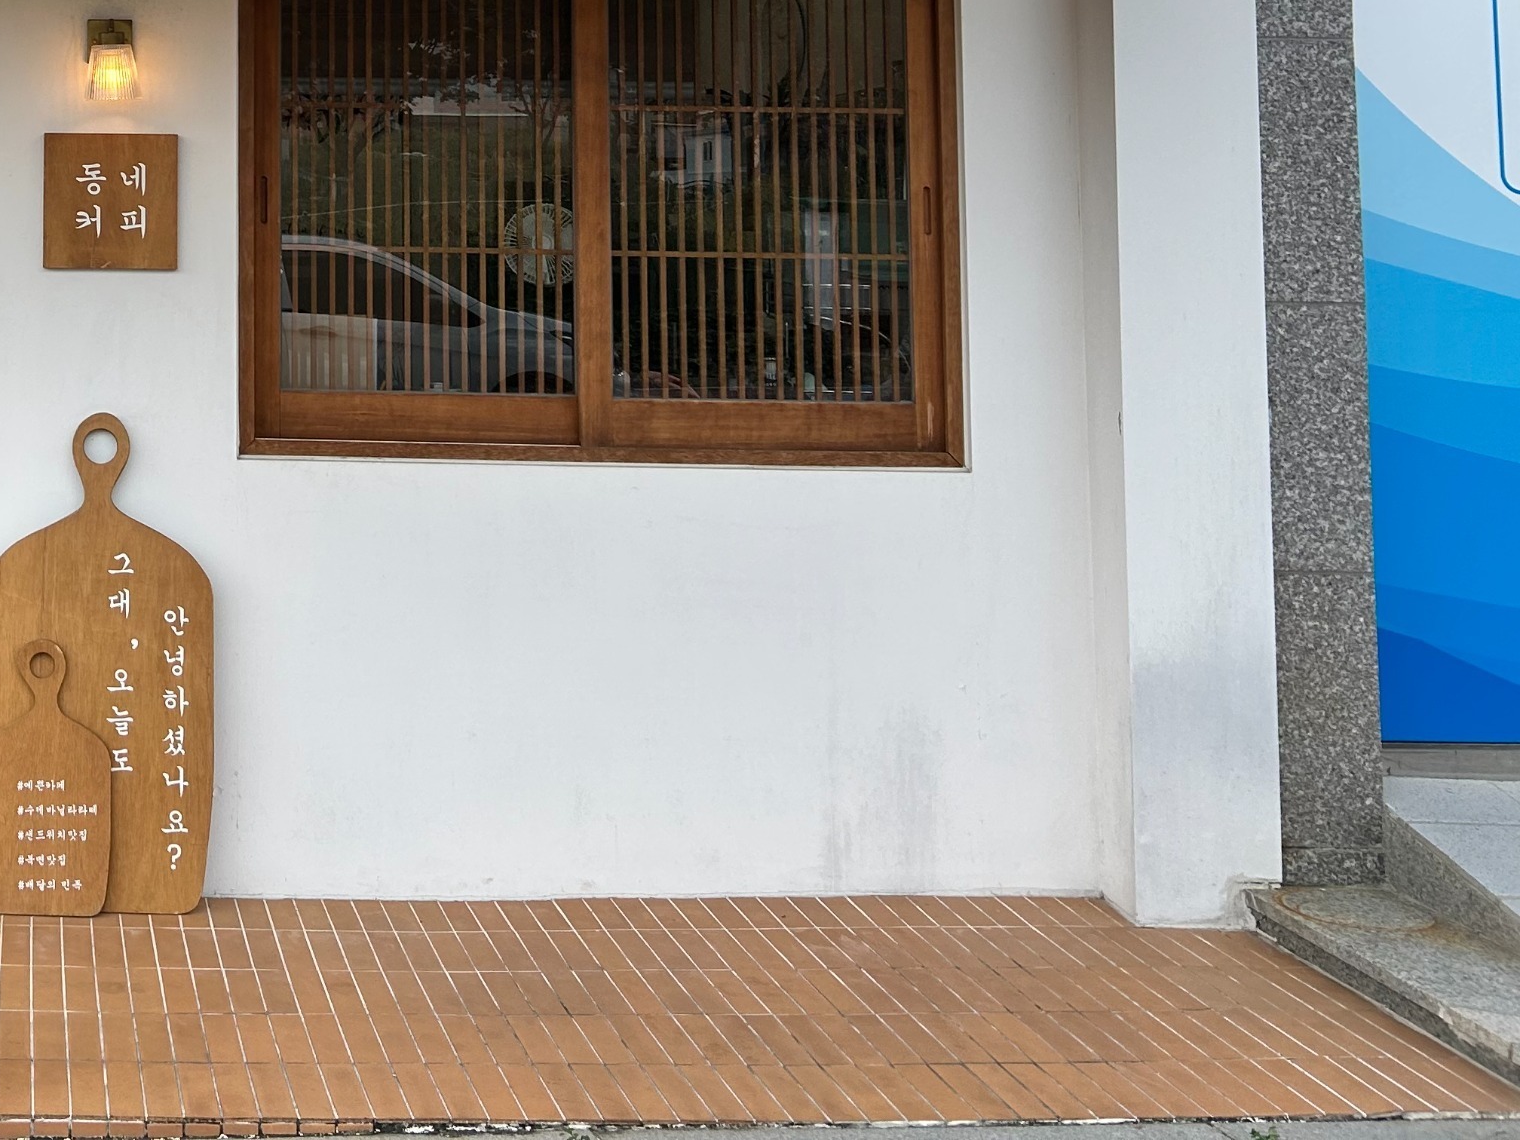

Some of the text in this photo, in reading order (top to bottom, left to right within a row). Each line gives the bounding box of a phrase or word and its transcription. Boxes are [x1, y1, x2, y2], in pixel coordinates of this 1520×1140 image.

[75, 162, 146, 196] 동네
[75, 204, 146, 239] 커피
[161, 605, 190, 871] 안녕하셨나요?
